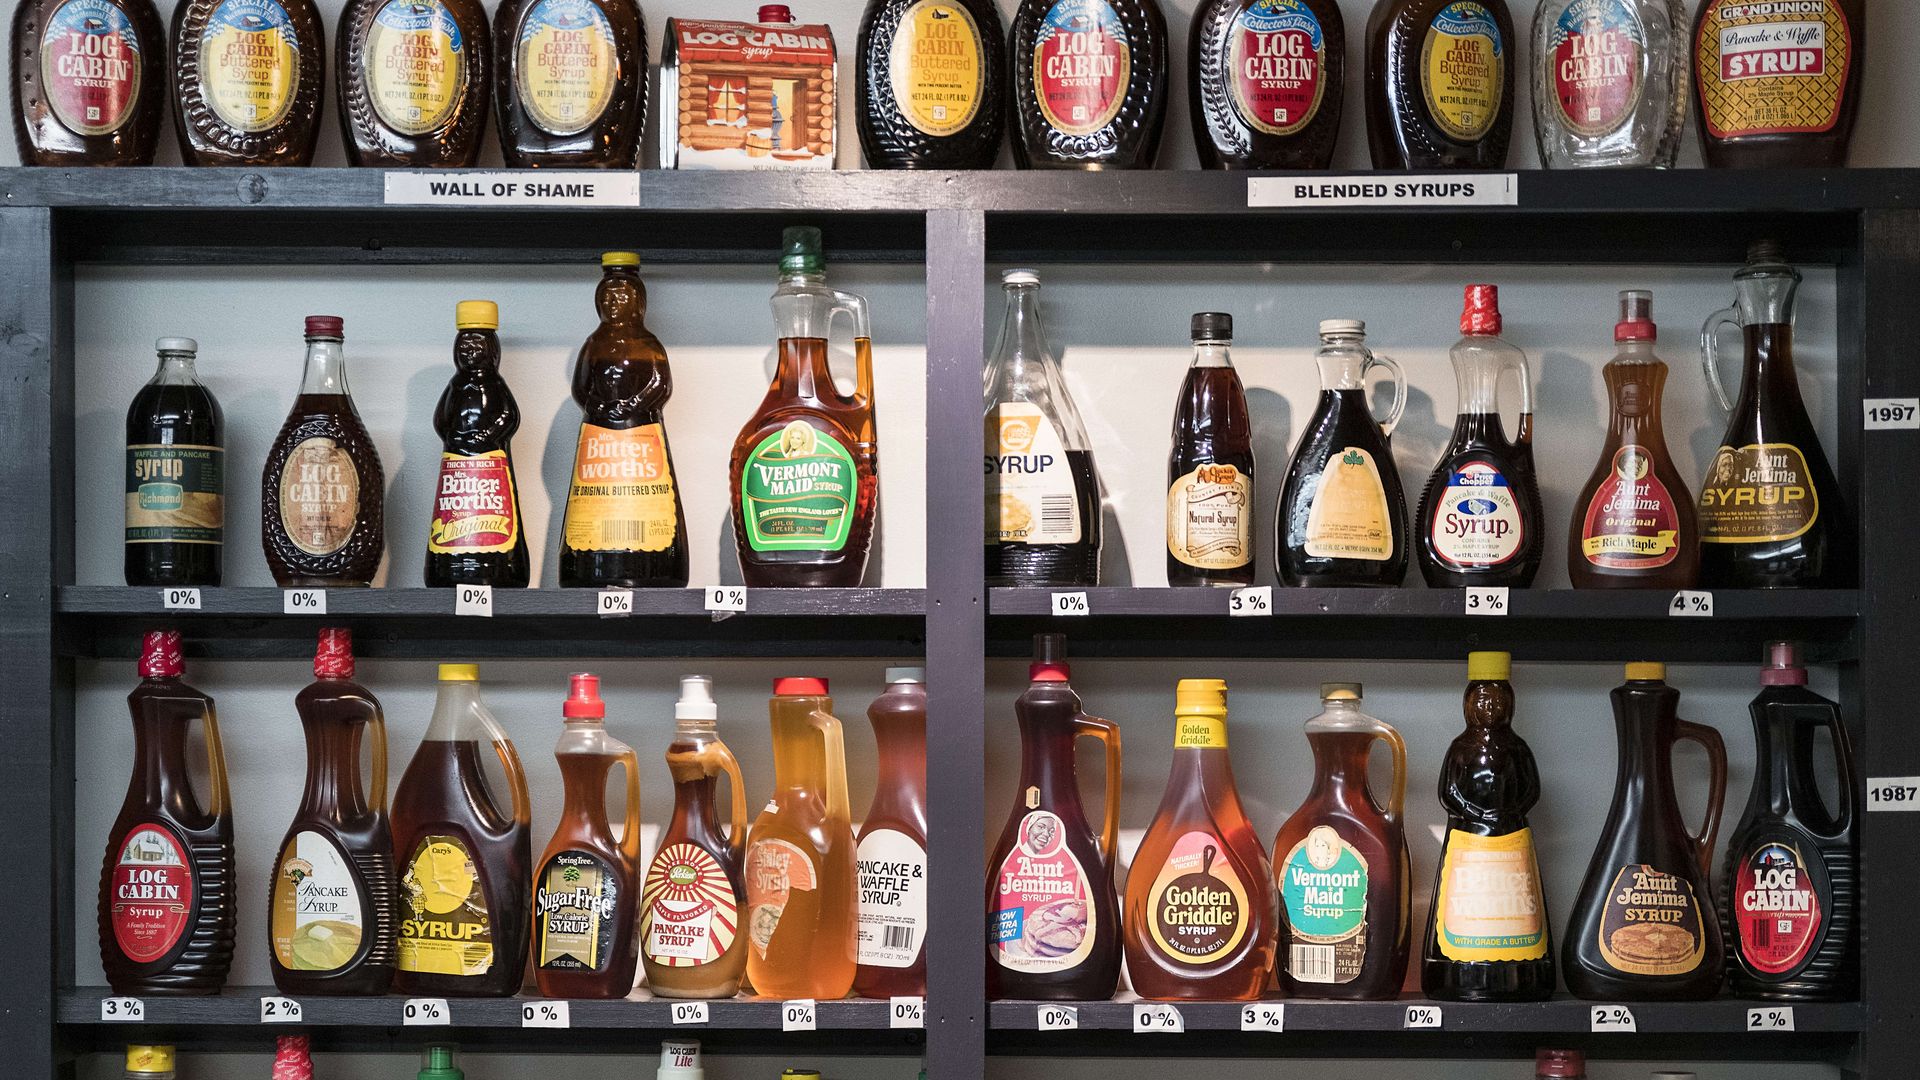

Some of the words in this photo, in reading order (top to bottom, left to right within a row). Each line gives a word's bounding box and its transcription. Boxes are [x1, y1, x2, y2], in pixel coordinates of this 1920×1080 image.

[1450, 1, 1485, 16] SPECIAL
[235, 32, 267, 44] LOG
[552, 31, 583, 42] LOG
[925, 23, 958, 39] LOG
[1725, 29, 1772, 47] Pancake
[1773, 30, 1784, 41] &
[70, 33, 118, 57] LOG
[401, 34, 431, 46] LOG
[682, 31, 739, 46] LOG
[745, 31, 828, 50] CABIN
[1057, 32, 1105, 55] LOG
[1256, 34, 1305, 57] LOG
[1453, 38, 1480, 51] LOG
[1571, 31, 1618, 58] LOG
[226, 43, 275, 57] CABIN
[392, 45, 439, 59] CABIN
[916, 40, 964, 56] CABIN
[385, 55, 445, 72] Buttered
[538, 54, 597, 67] Buttered
[911, 55, 971, 71] Buttered
[1446, 50, 1486, 65] CABIN
[1729, 51, 1816, 76] SYRUP
[58, 55, 128, 81] CABIN
[232, 67, 269, 80] Syrup
[549, 66, 585, 79] Syrup
[1047, 55, 1116, 79] CABIN
[1245, 57, 1313, 80] CABIN
[1440, 60, 1490, 78] Buttered
[1561, 54, 1629, 82] CABIN
[74, 79, 117, 88] SYRUP
[922, 69, 959, 84] Syrup
[1061, 78, 1102, 87] SYRUP
[1451, 73, 1481, 88] Syrup
[1261, 80, 1302, 89] SYRUP
[430, 182, 485, 196] WALL
[491, 183, 517, 196] OF
[524, 184, 594, 198] SHAME
[1294, 184, 1387, 199] BLENDED
[1394, 183, 1475, 198] SYRUPS
[1869, 407, 1915, 422] 1997
[178, 451, 210, 459] PANCAKE
[1755, 453, 1789, 468] Aunt
[135, 459, 183, 481] syrup
[582, 460, 657, 479] worth's
[753, 462, 842, 487] VERMONT
[1474, 473, 1494, 481] Price
[1742, 467, 1797, 483] Jemima
[770, 478, 813, 496] MAID
[814, 482, 843, 492] SYRUP
[1459, 477, 1494, 486] Chopper
[1615, 480, 1651, 496] Aunt
[580, 485, 610, 496] ORIGINAL
[612, 485, 650, 496] BUTTERED
[651, 484, 670, 495] SYRUP
[1700, 487, 1806, 506] SYRUP
[439, 492, 504, 511] worth's
[1446, 489, 1475, 508] Pancake
[1488, 491, 1511, 508] Waffle
[1603, 496, 1661, 512] Jemima
[1189, 511, 1215, 525] Natural
[1217, 510, 1237, 526] Syrup
[1445, 513, 1509, 538] Syrup
[1605, 518, 1656, 527] Original
[443, 517, 505, 541] Original
[1602, 539, 1624, 547] Rich
[1625, 539, 1657, 551] Maple
[170, 590, 196, 606] 0%
[292, 592, 317, 607] 0%
[463, 589, 488, 605] 0%
[603, 596, 628, 611] 0%
[714, 591, 724, 603] 0
[729, 591, 744, 605] %
[1059, 596, 1085, 610] 0%
[1231, 596, 1243, 611] 3
[1249, 595, 1267, 611] %
[1468, 595, 1480, 609] 3
[1486, 595, 1504, 609] %
[1673, 596, 1686, 611] 4
[1692, 596, 1709, 611] %
[1182, 724, 1210, 735] Golden
[1180, 735, 1211, 745] Griddle
[1871, 787, 1918, 802] 1987
[432, 847, 452, 855] Cary's
[912, 864, 923, 878] &
[1017, 856, 1065, 877] Aunt
[1174, 860, 1200, 871] THICKER!
[128, 869, 168, 884] LOG
[860, 875, 910, 892] WAFFLE
[1000, 872, 1075, 895] Jemima
[1291, 868, 1360, 887] Vermont
[1633, 872, 1678, 891] Aunt
[1754, 868, 1796, 890] LOG
[118, 884, 180, 899] CABIN
[298, 881, 348, 897] PANCAKE
[1166, 885, 1232, 906] Golden
[1303, 886, 1344, 905] Maid
[862, 890, 900, 906] SYRUP
[1021, 894, 1052, 902] SYRUP
[1616, 887, 1688, 907] Jemima
[1743, 890, 1810, 911] CABIN
[129, 906, 164, 919] Syrup
[564, 913, 590, 922] Calorie
[672, 904, 708, 921] FLAVORED
[995, 911, 1017, 921] NOW
[1163, 905, 1233, 926] Griddle
[1303, 905, 1344, 919] Syrup
[1624, 908, 1684, 923] SYRUP
[401, 919, 484, 940] SYRUP
[549, 920, 590, 933] SYRUP
[654, 923, 705, 937] PANCAKE
[991, 922, 1018, 932] EXTRA
[1178, 926, 1217, 935] SYRUP
[659, 935, 695, 947] SYRUP
[1475, 938, 1501, 946] GRADE
[1510, 936, 1536, 945] BUTTER
[106, 1000, 117, 1015] 3
[123, 1001, 141, 1015] %
[264, 1001, 276, 1015] 2
[282, 1001, 299, 1015] %
[404, 1004, 416, 1018] 0
[422, 1003, 440, 1018] %
[523, 1006, 535, 1020] 0
[540, 1006, 558, 1020] %
[676, 1005, 702, 1020] 0%
[895, 1004, 920, 1020] 0%
[787, 1008, 812, 1023] 0%
[1045, 1011, 1071, 1026] 0%
[1140, 1012, 1151, 1026] 0
[1244, 1010, 1256, 1024] 3
[1263, 1011, 1279, 1026] %
[1408, 1009, 1434, 1024] 0%
[1595, 1010, 1607, 1024] 2
[1613, 1010, 1631, 1024] %
[1751, 1012, 1763, 1027] 2
[1768, 1012, 1786, 1027] %
[669, 1046, 681, 1055] LOG
[674, 1055, 693, 1067] Lite
